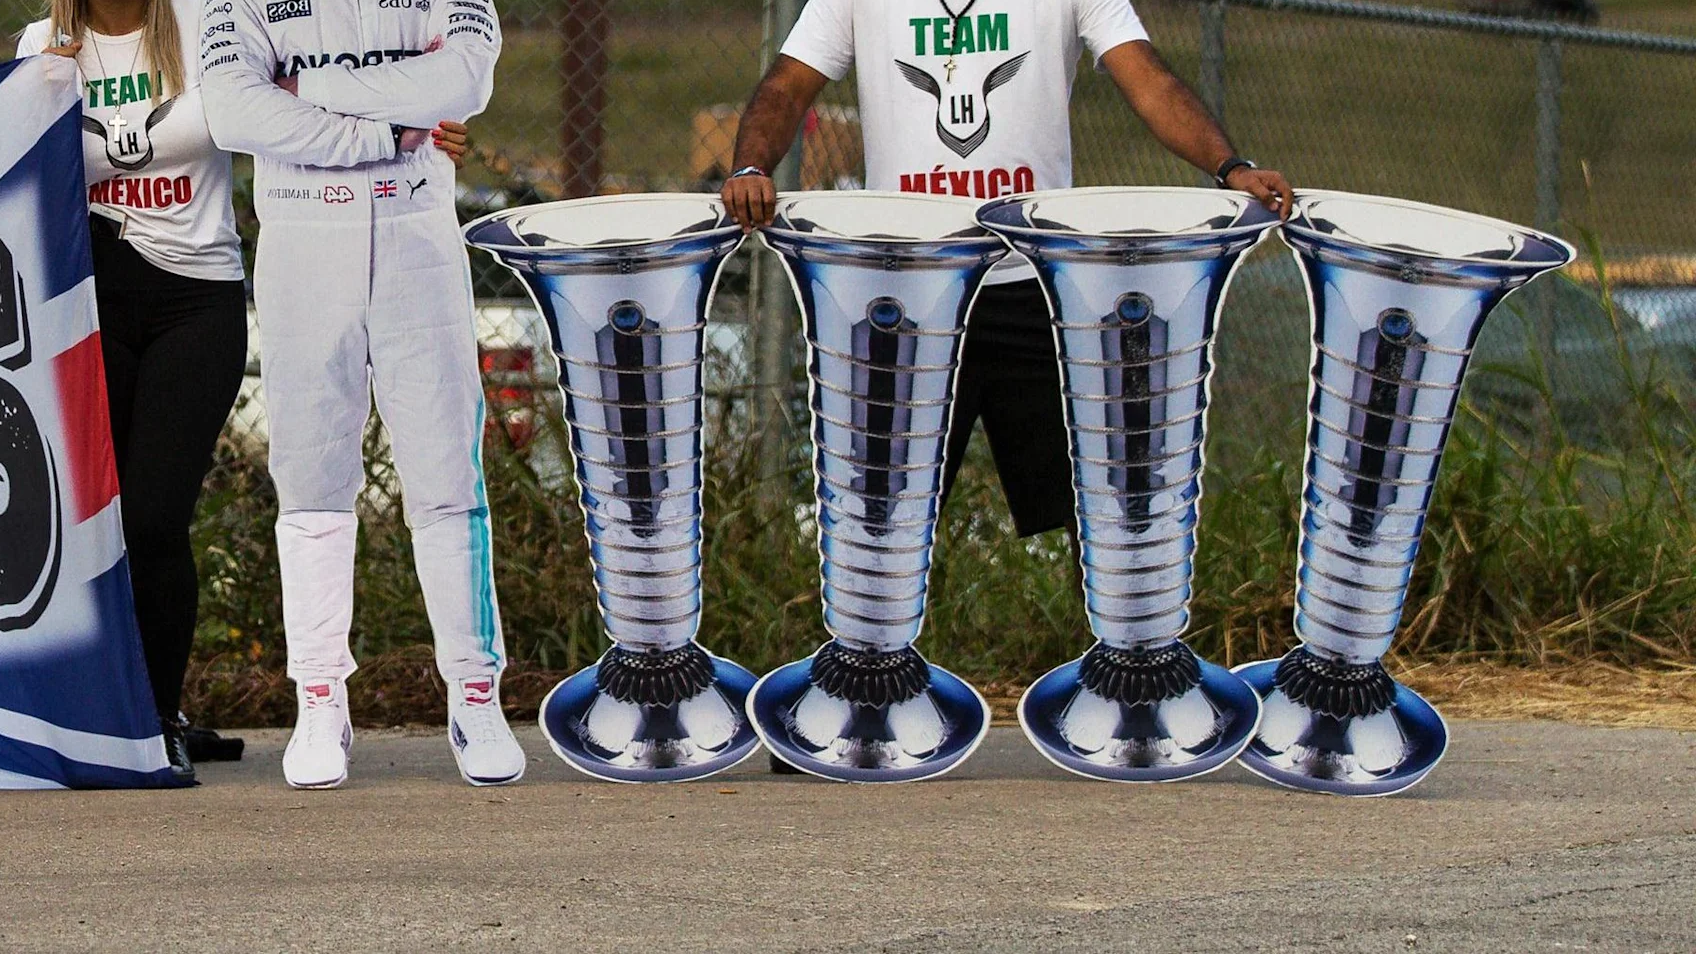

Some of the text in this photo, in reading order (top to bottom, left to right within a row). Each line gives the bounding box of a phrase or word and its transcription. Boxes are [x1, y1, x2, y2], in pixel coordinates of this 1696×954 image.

[909, 12, 1009, 56] TEAM
[950, 94, 974, 124] LH
[118, 131, 139, 156] LH
[89, 173, 192, 209] MÉXICO
